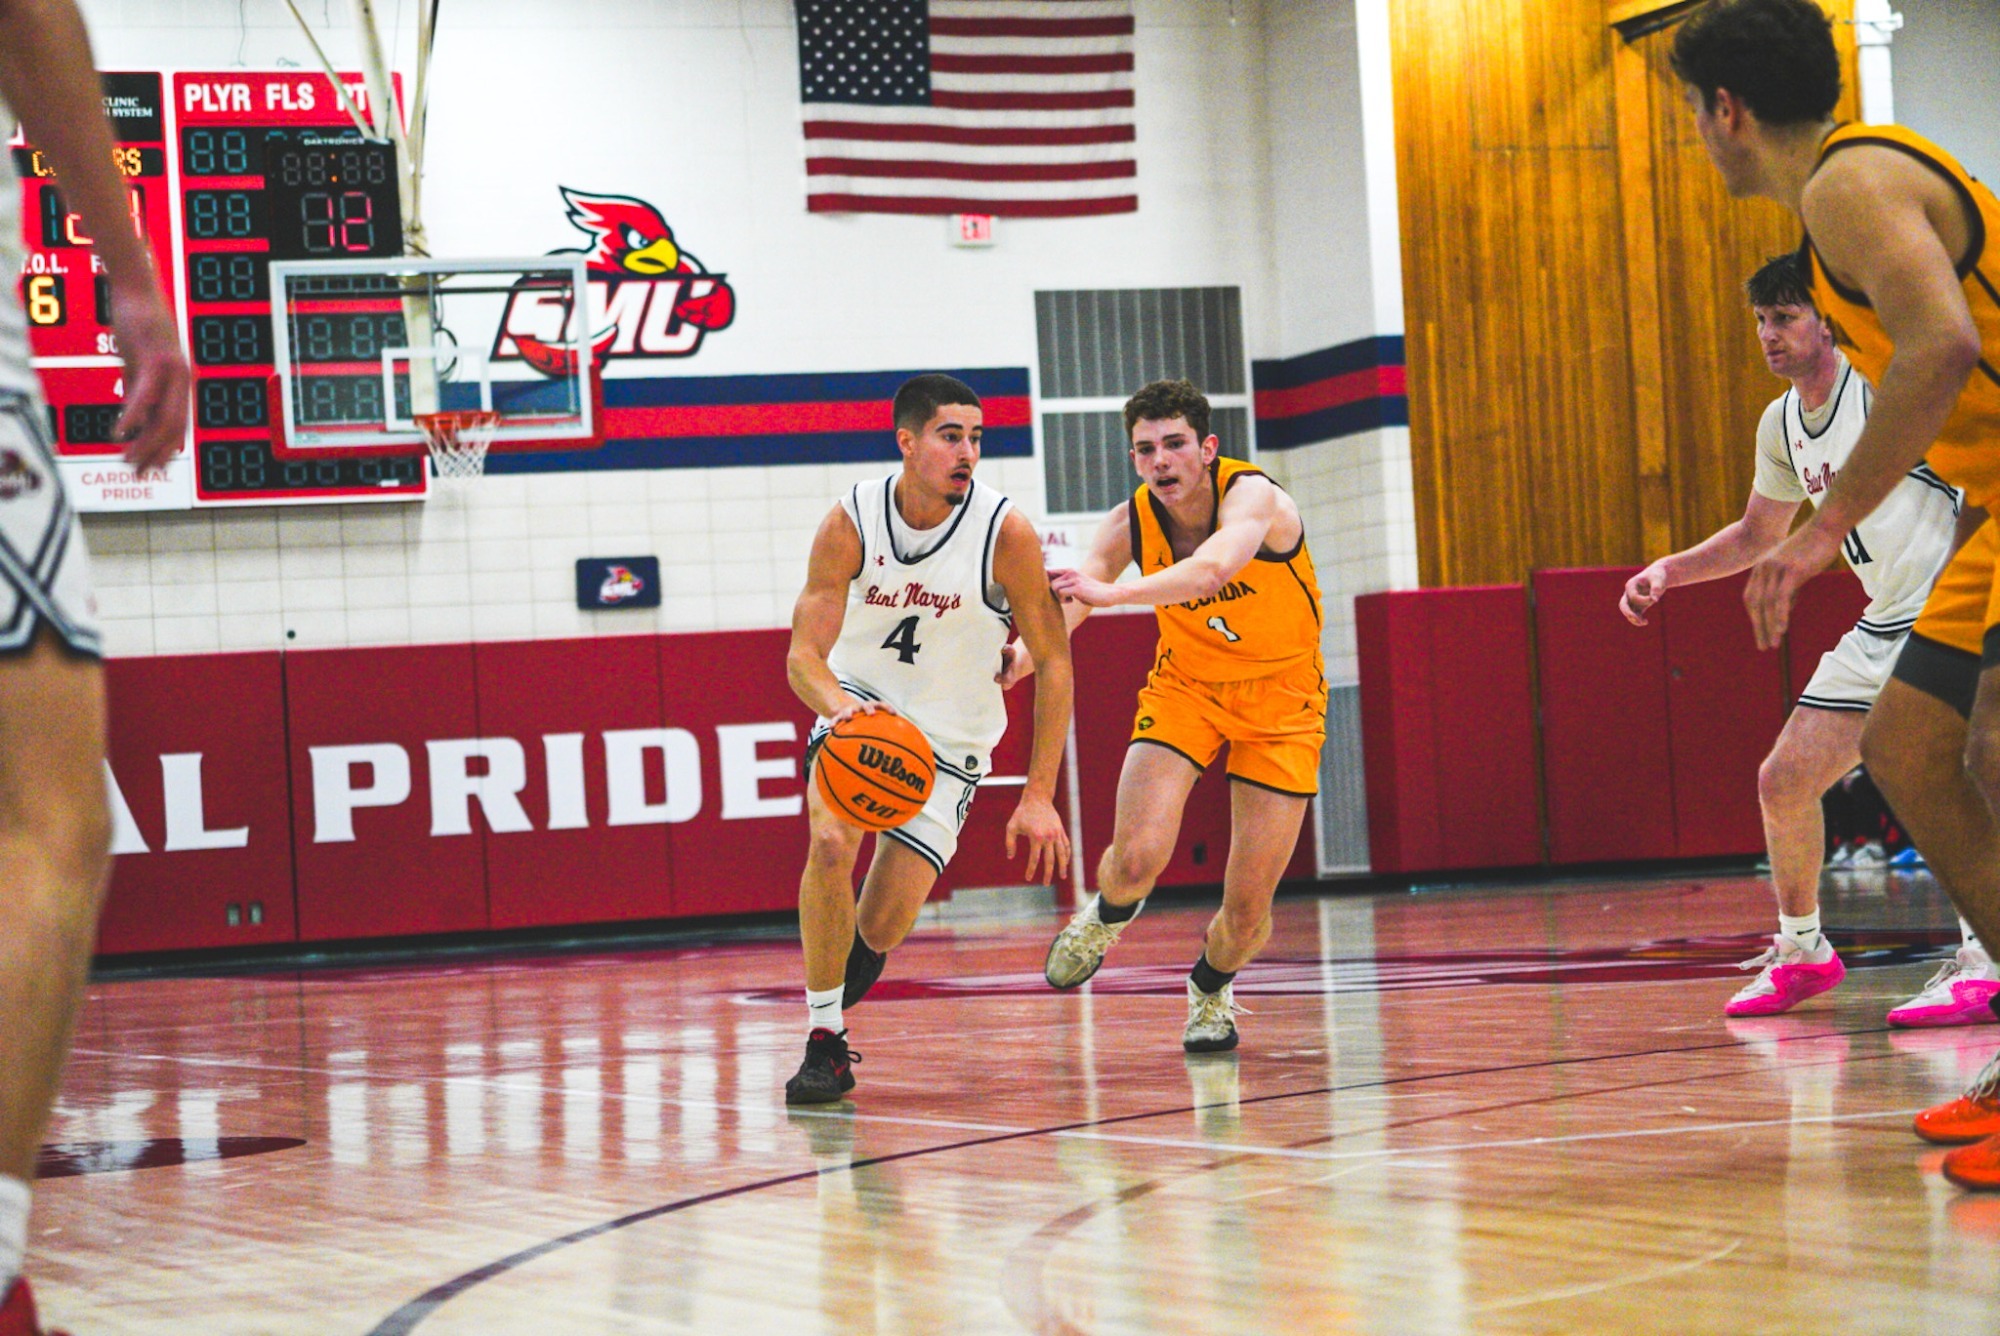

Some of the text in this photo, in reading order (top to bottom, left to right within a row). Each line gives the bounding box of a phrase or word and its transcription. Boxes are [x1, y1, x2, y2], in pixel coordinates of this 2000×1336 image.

[112, 107, 153, 117] SYSTEM
[184, 83, 252, 112] PLYR
[265, 82, 316, 111] FLS
[29, 276, 60, 324] 6
[102, 487, 154, 500] PRIDE
[903, 582, 962, 619] Mary's
[880, 615, 922, 665] 4
[1206, 615, 1242, 642] 1
[309, 721, 803, 844] PRIDE
[858, 743, 927, 795] Wilson
